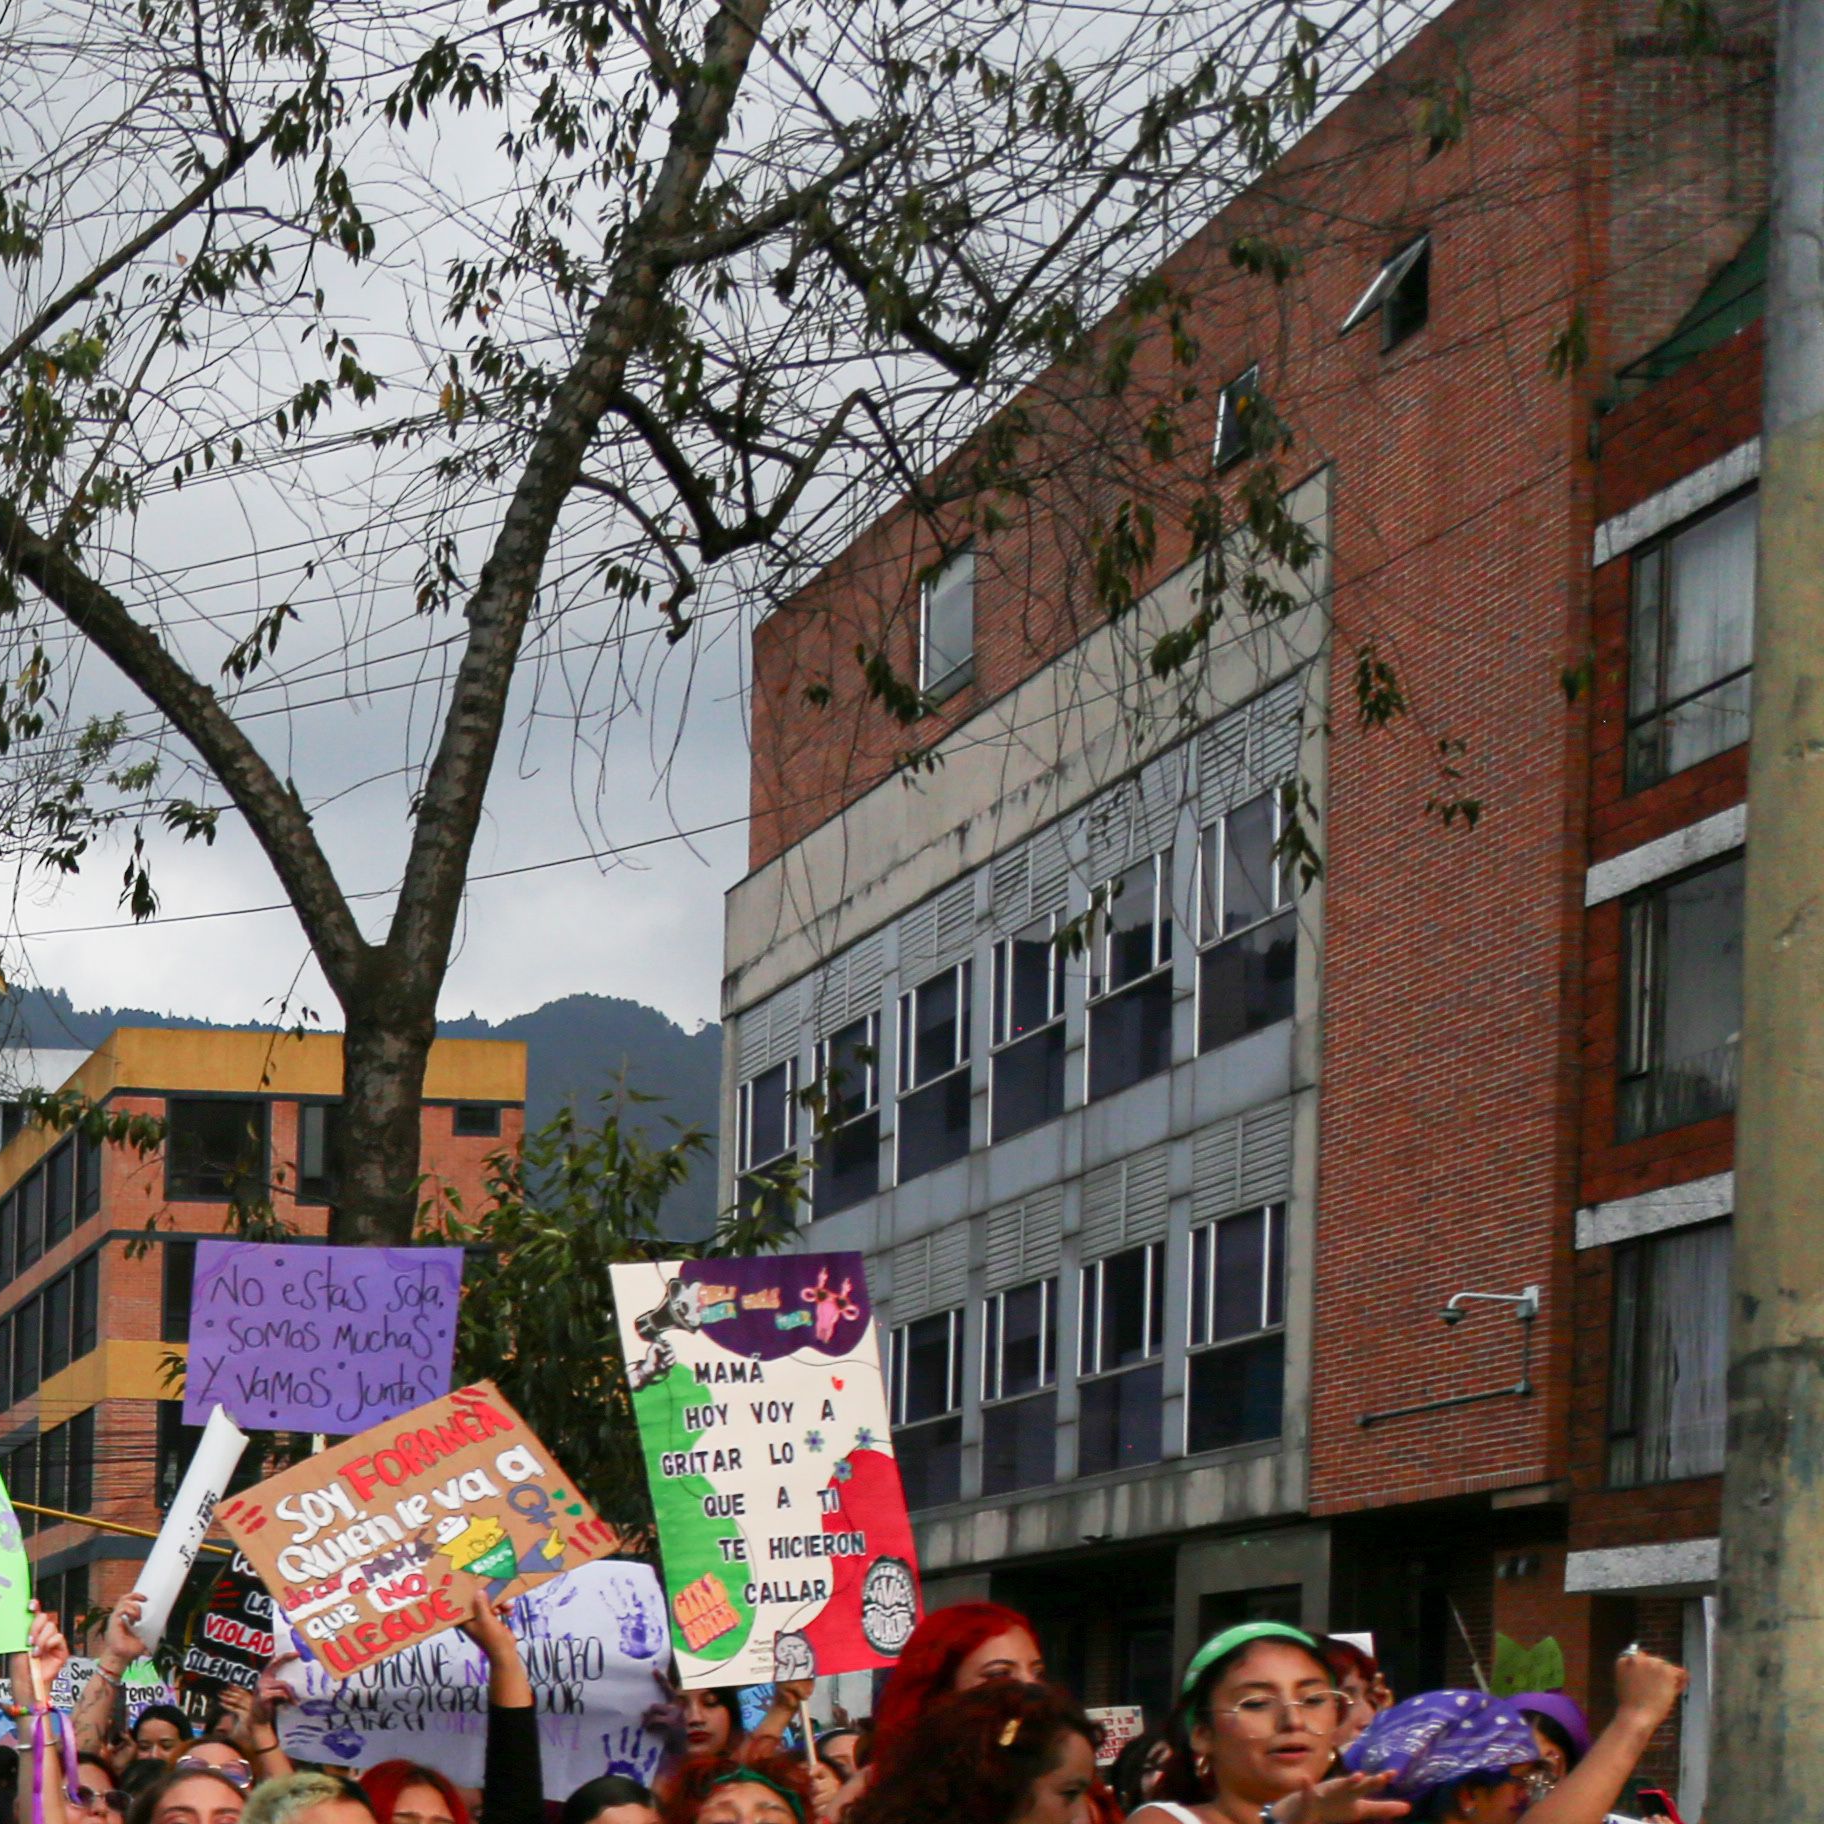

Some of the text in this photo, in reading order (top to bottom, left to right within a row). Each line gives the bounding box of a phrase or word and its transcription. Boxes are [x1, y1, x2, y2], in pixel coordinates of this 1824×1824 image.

[694, 1352, 764, 1385] MAMÁ
[685, 1399, 835, 1431] HOY VOY A
[662, 1442, 794, 1477] GRITAR LO
[704, 1486, 840, 1518] QUE A TI
[719, 1531, 866, 1563] TE HICIERON
[371, 1572, 429, 1606] NO
[744, 1578, 828, 1605] CALLAR
